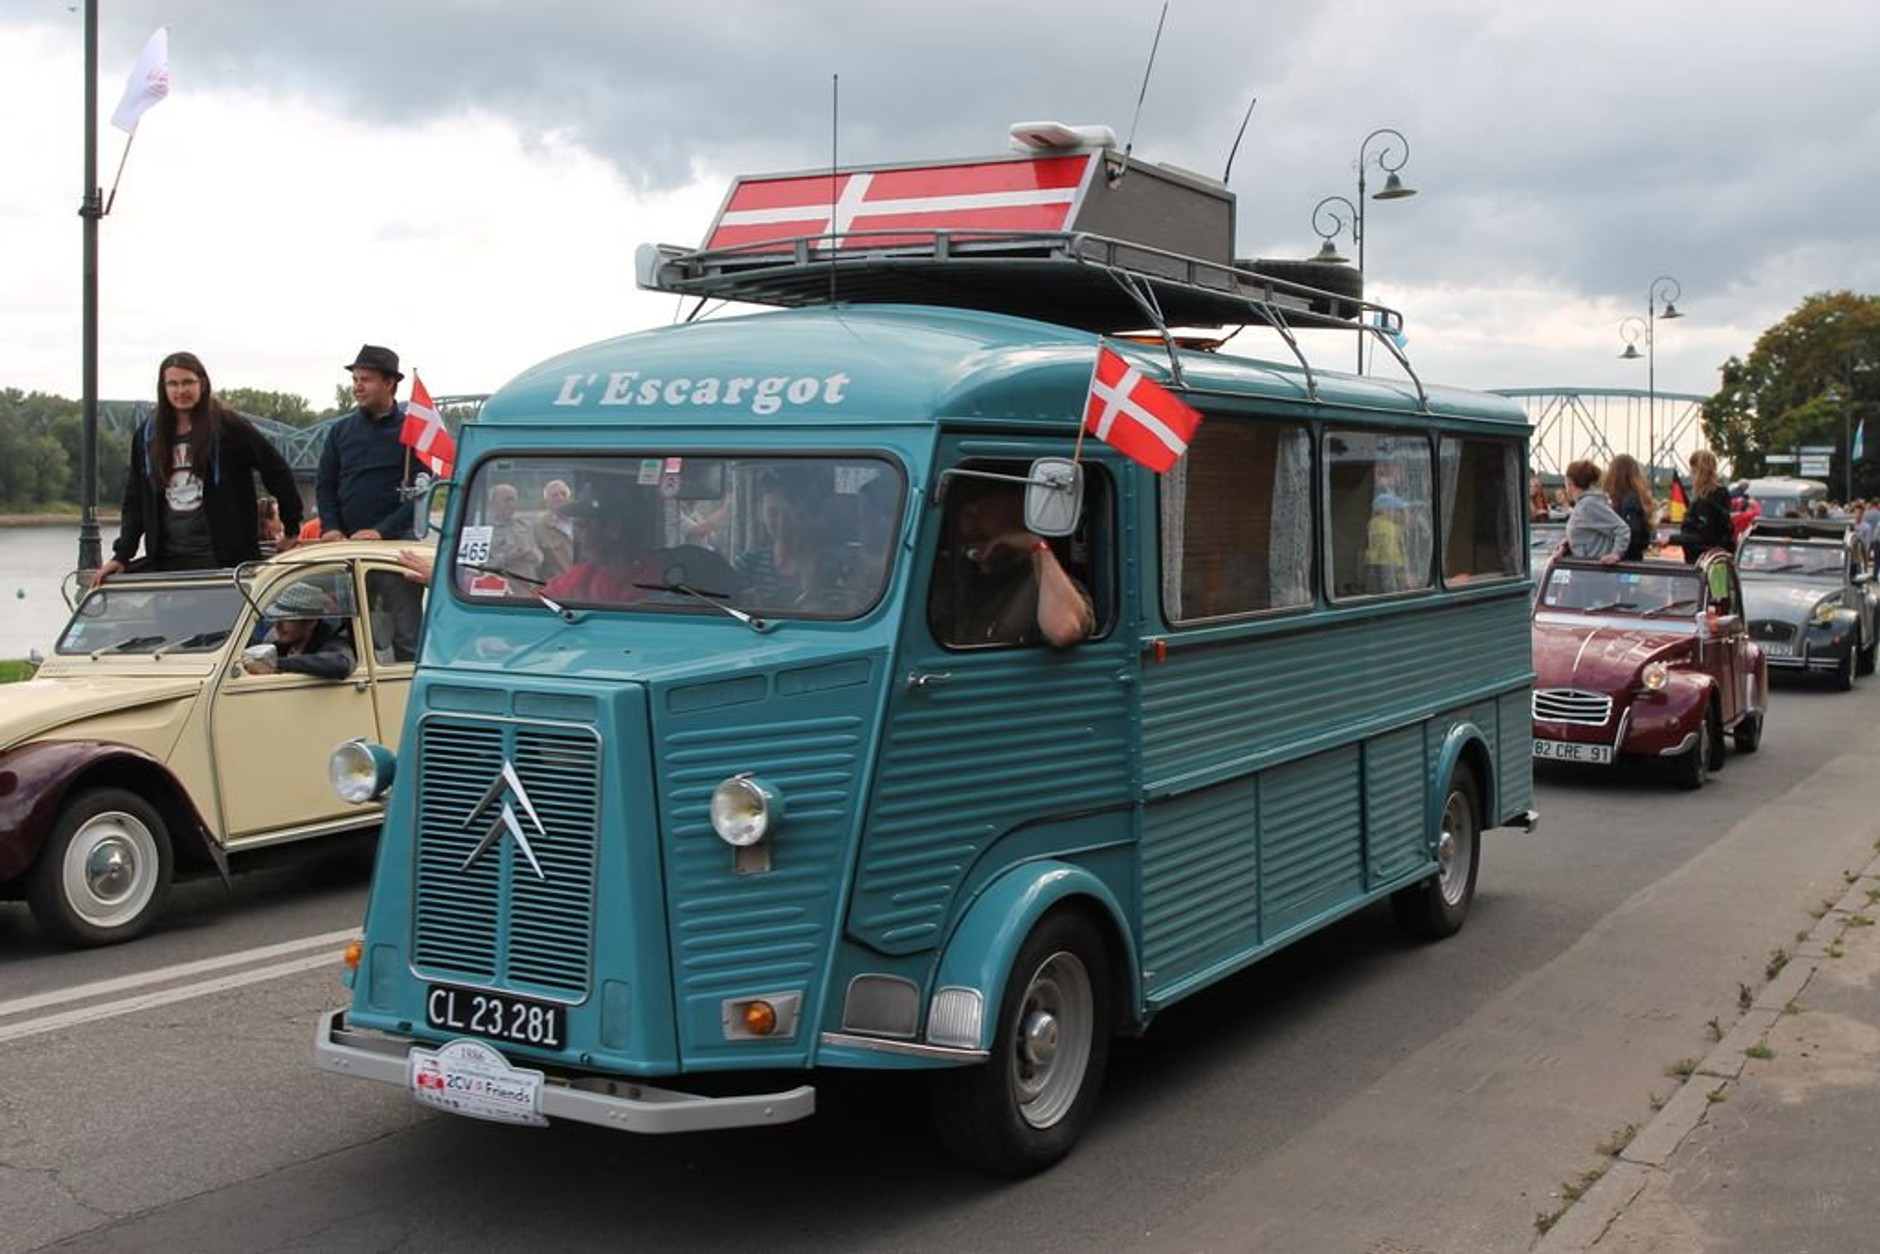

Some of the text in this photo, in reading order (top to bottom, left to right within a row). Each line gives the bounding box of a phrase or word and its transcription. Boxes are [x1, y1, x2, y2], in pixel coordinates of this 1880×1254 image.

[552, 370, 850, 415] L'Escargot
[458, 542, 489, 561] 465
[1535, 741, 1608, 761] 82 CRE 91
[429, 989, 558, 1045] CL 23.281
[446, 1072, 473, 1091] 2CV
[484, 1080, 531, 1104] Friends
